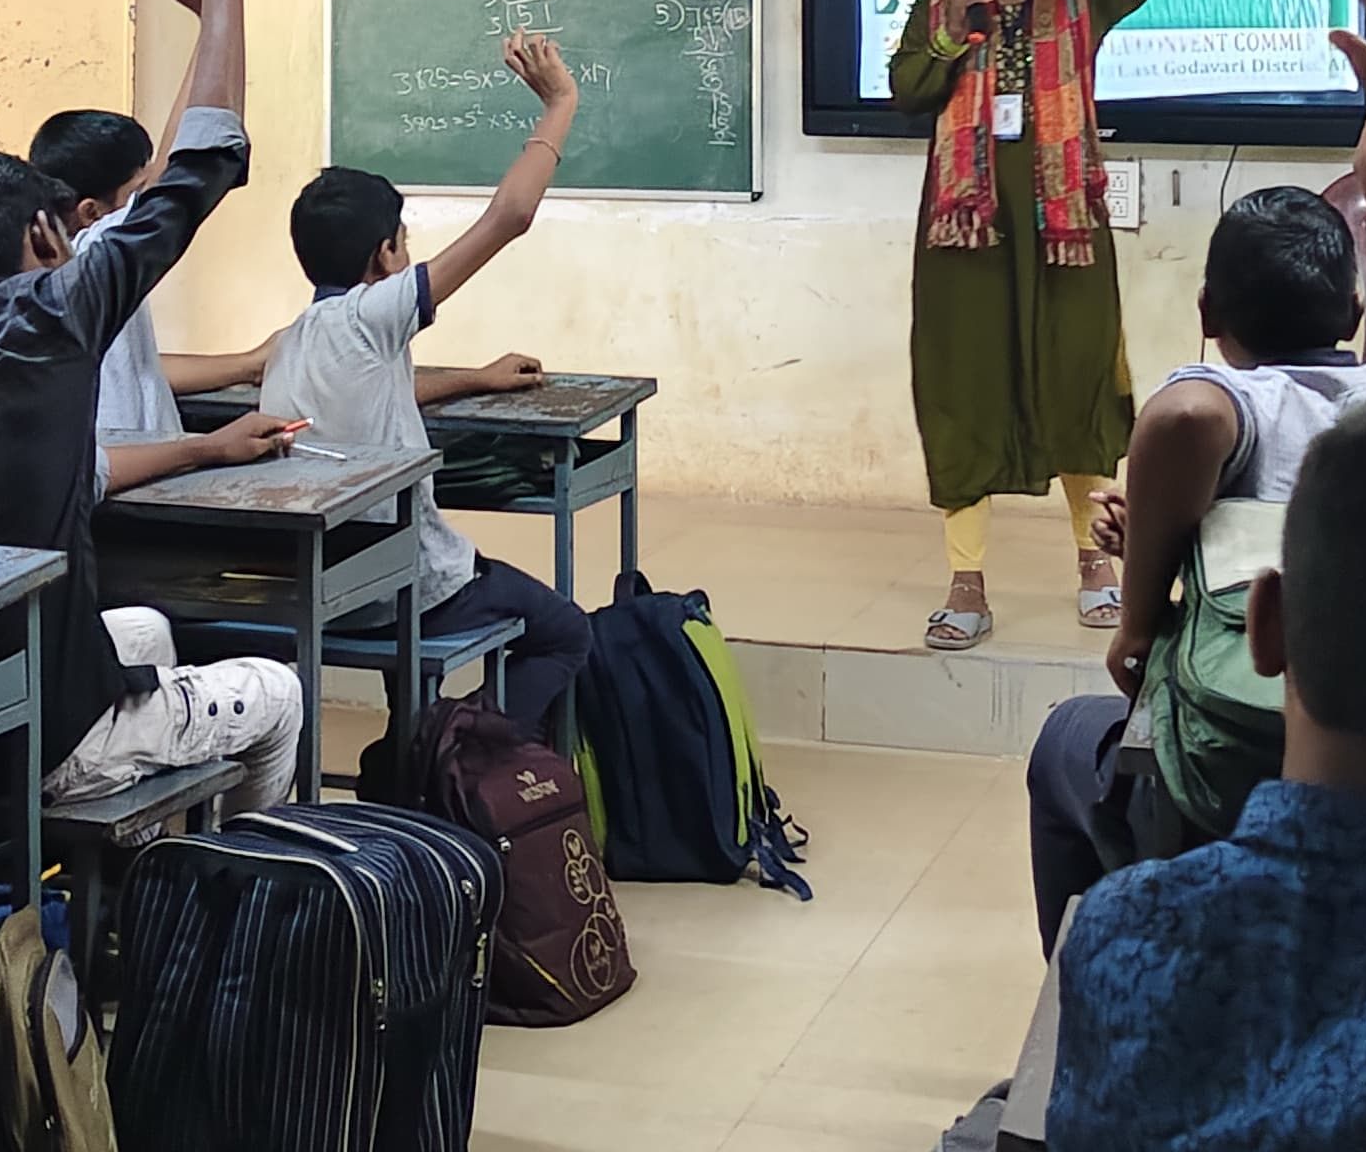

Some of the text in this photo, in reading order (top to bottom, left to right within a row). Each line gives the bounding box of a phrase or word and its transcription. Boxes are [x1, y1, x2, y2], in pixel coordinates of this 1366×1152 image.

[516, 2, 552, 27] 51
[1164, 53, 1247, 76] Godavari
[1251, 50, 1325, 74] Distri
